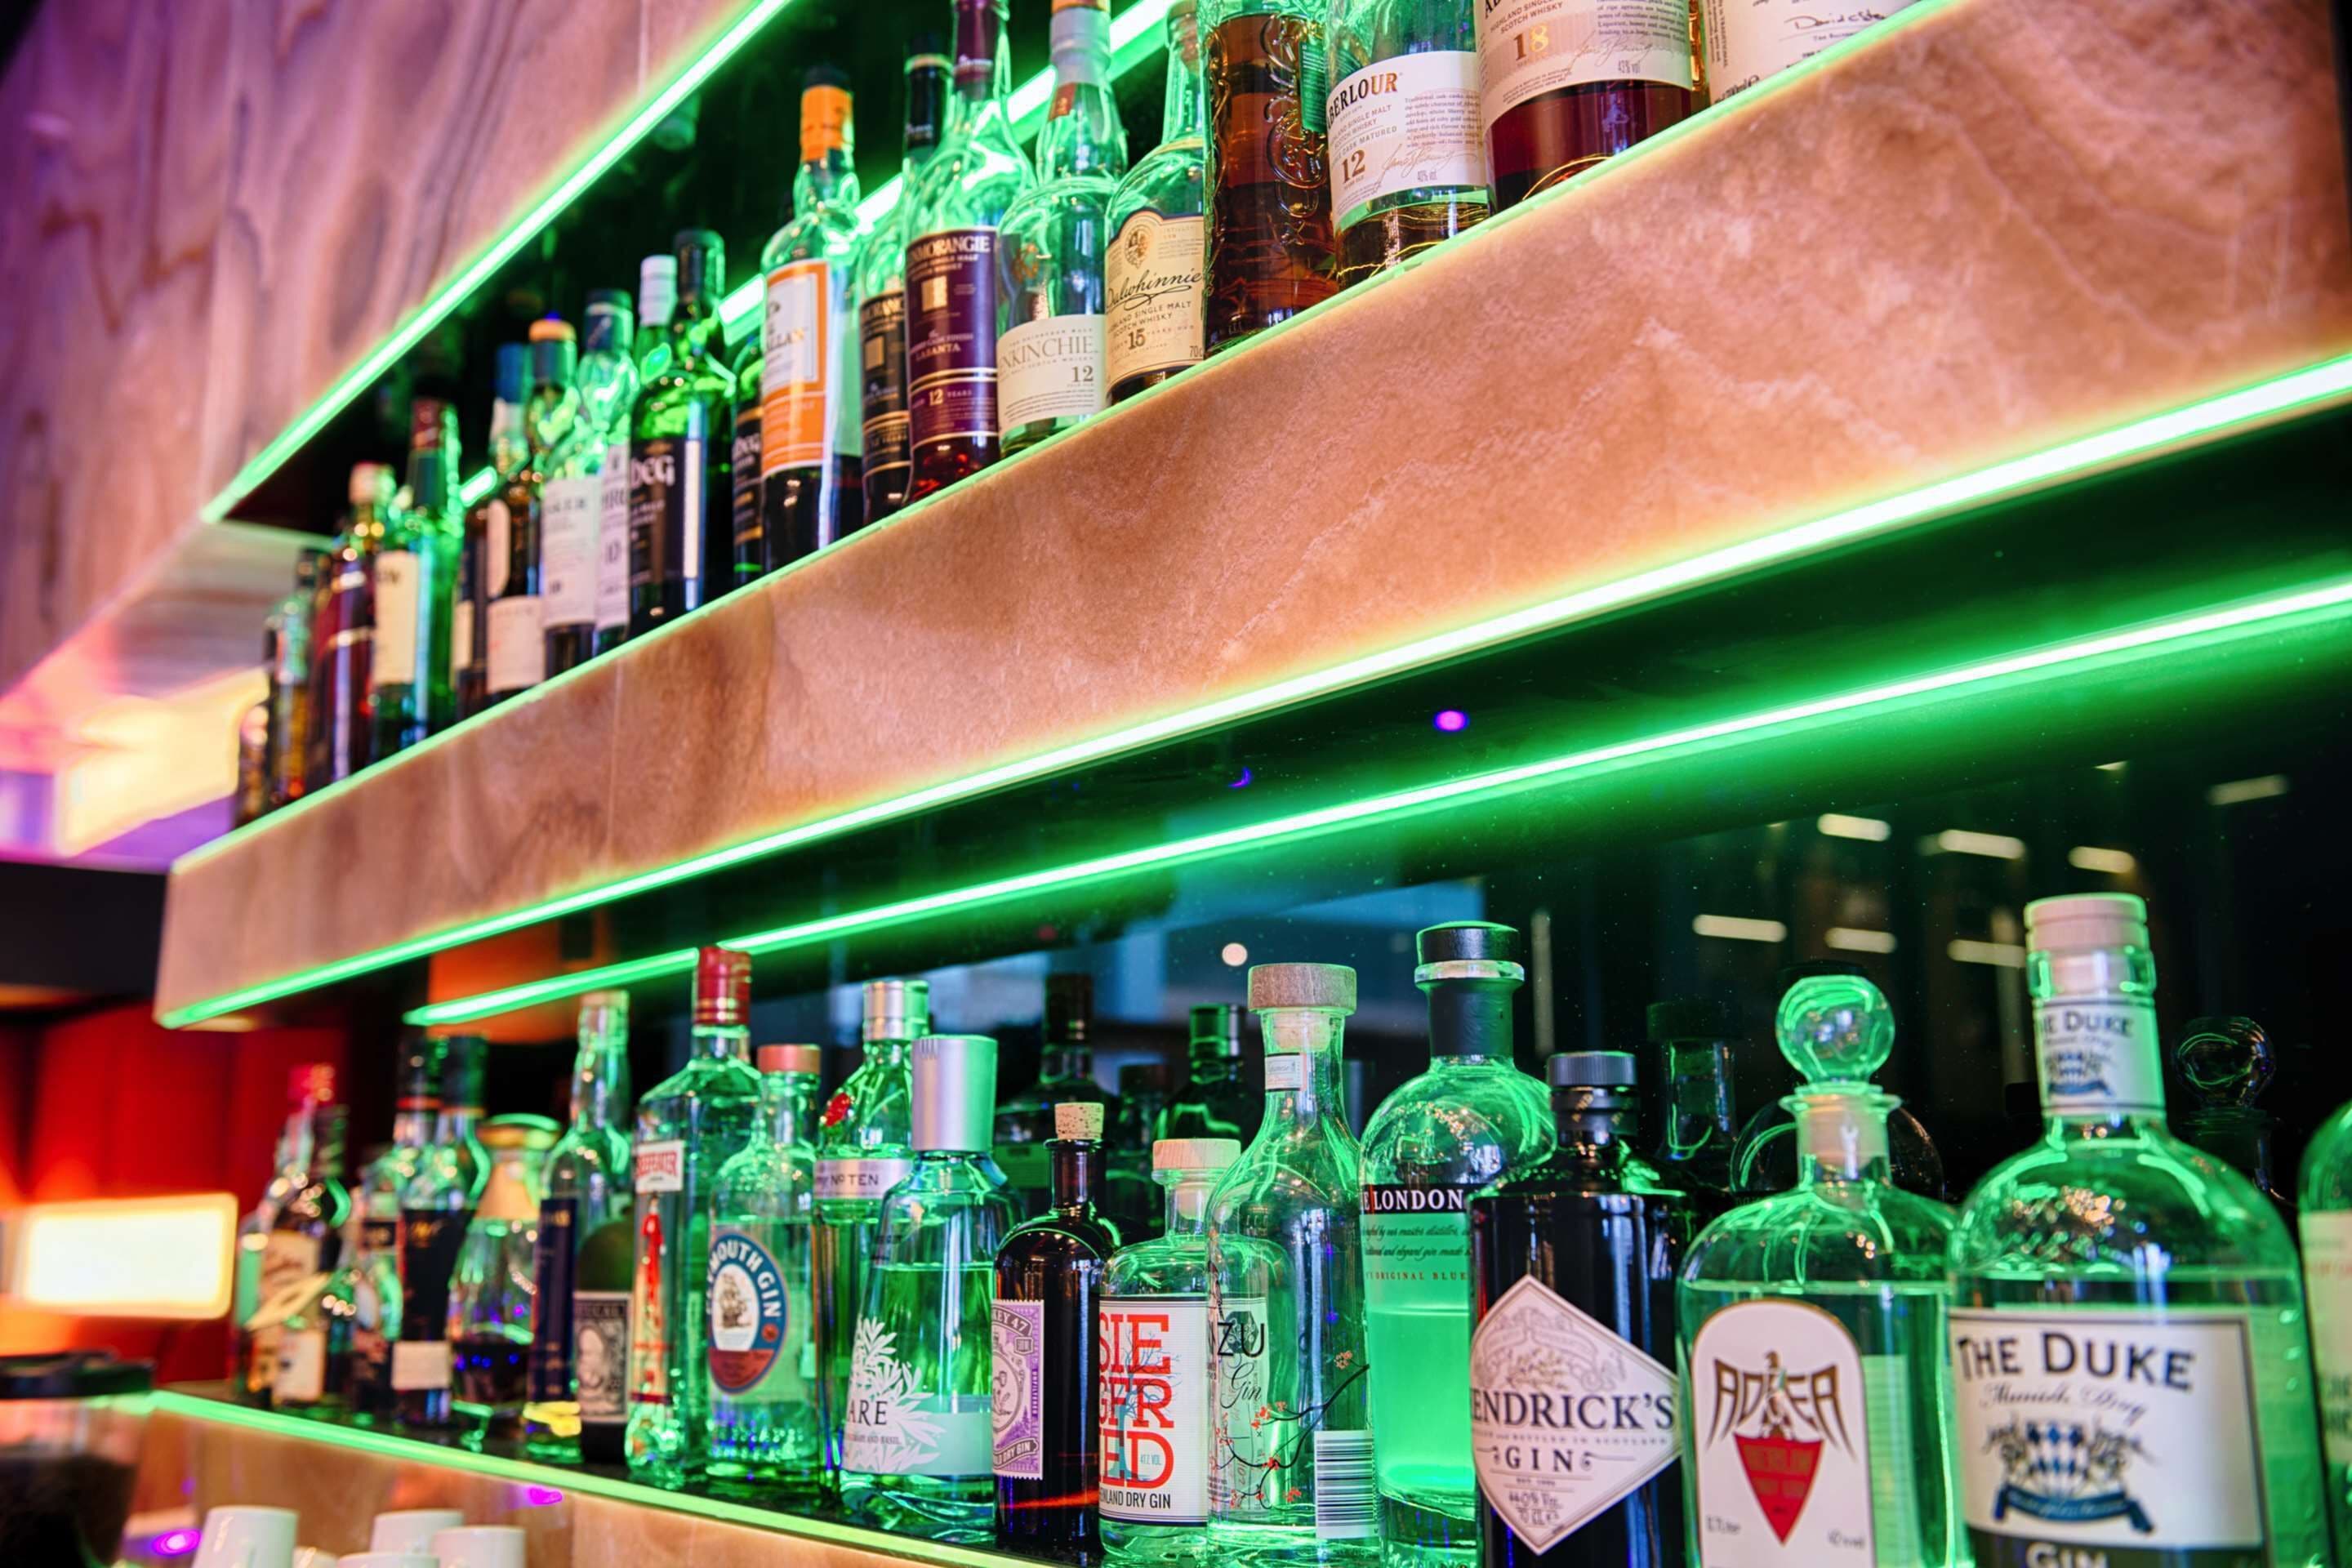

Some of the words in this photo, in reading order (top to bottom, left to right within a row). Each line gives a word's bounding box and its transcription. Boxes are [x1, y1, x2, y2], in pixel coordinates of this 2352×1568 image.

[1501, 12, 1529, 33] SCOTCH
[1530, 2, 1563, 17] WHISKY
[1513, 22, 1550, 61] 18
[1348, 112, 1371, 129] SINGLE
[1371, 104, 1392, 115] MALT
[1352, 118, 1378, 134] WHISKY
[1342, 141, 1357, 156] CASK
[1359, 126, 1397, 145] MATURED
[1342, 149, 1366, 184] 12
[1134, 305, 1163, 318] SINGLE
[1167, 300, 1192, 310] MALT
[1139, 312, 1173, 325] WHISKY
[1128, 327, 1146, 350] 15
[1071, 365, 1094, 382] 12
[929, 388, 944, 407] 12
[2064, 1010, 2134, 1039] DUKE
[848, 1174, 879, 1186] TEN
[1374, 1188, 1464, 1210] LONDON
[1375, 1271, 1425, 1281] ORIGINAL
[1432, 1271, 1468, 1281] BLUE
[757, 1271, 782, 1318] GIN
[1011, 1316, 1029, 1332] 47
[1957, 1335, 2024, 1382] THE
[2041, 1332, 2197, 1393] DUKE
[1220, 1362, 1263, 1409] Gin
[849, 1399, 889, 1427] ARE
[1980, 1380, 2070, 1409] Munich
[2081, 1388, 2148, 1427] Dry
[1017, 1441, 1031, 1454] GIN
[1506, 1446, 1573, 1472] GIN
[1126, 1491, 1147, 1508] DRY
[1149, 1493, 1171, 1509] GIN
